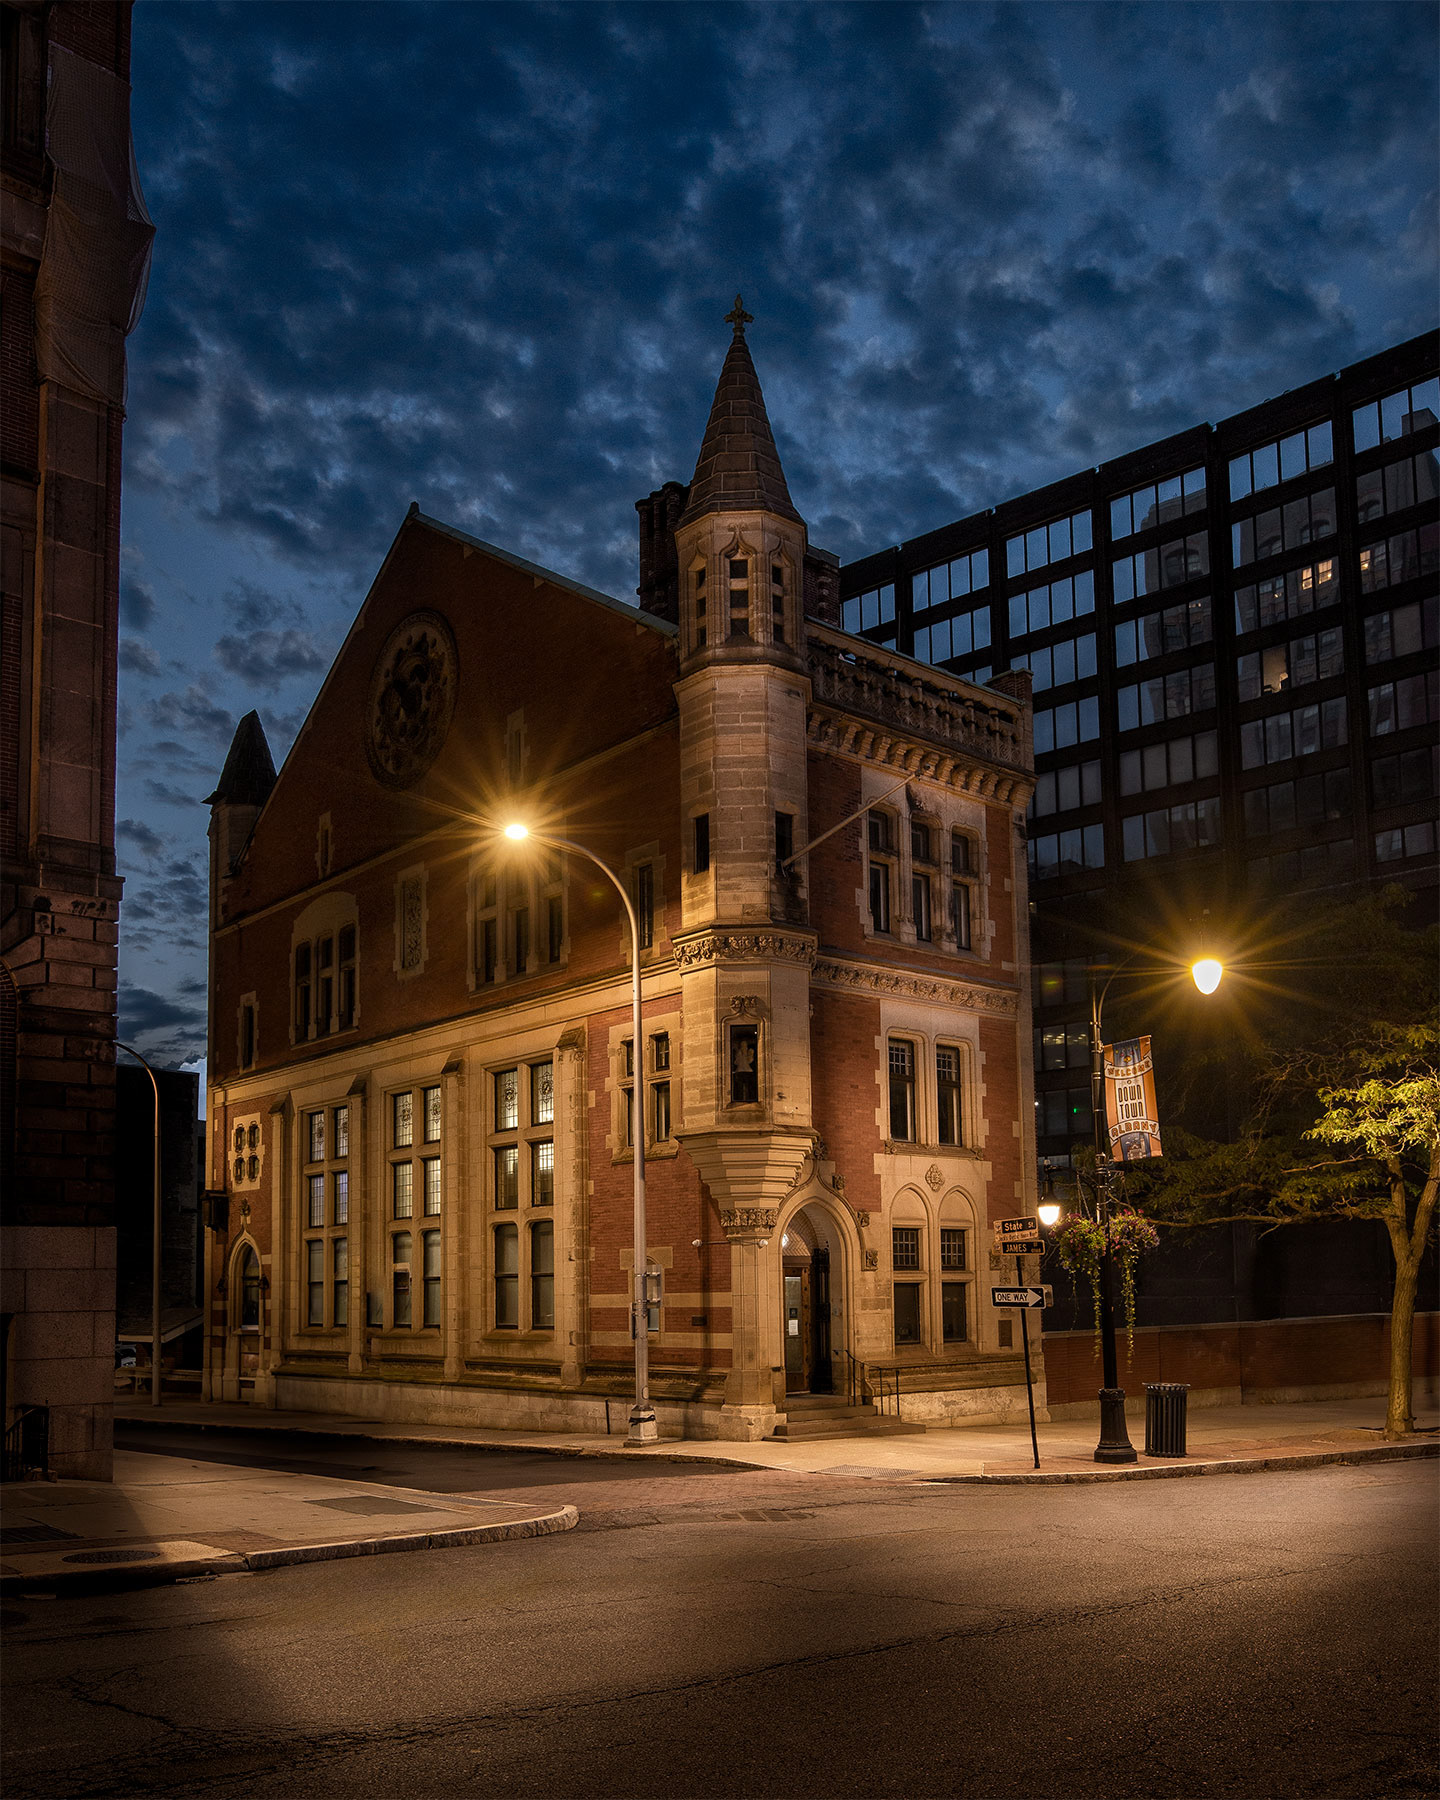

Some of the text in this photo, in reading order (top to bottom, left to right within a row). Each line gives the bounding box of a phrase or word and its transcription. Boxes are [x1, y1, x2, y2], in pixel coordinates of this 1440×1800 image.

[1107, 1060, 1150, 1076] WELCOME
[1118, 1085, 1142, 1102] DOWN
[1120, 1102, 1144, 1119] TOWN
[1111, 1121, 1157, 1137] ALBANY
[1004, 1222, 1023, 1231] State
[1006, 1244, 1027, 1252] JAMES
[997, 1293, 1028, 1301] ONE WAY
